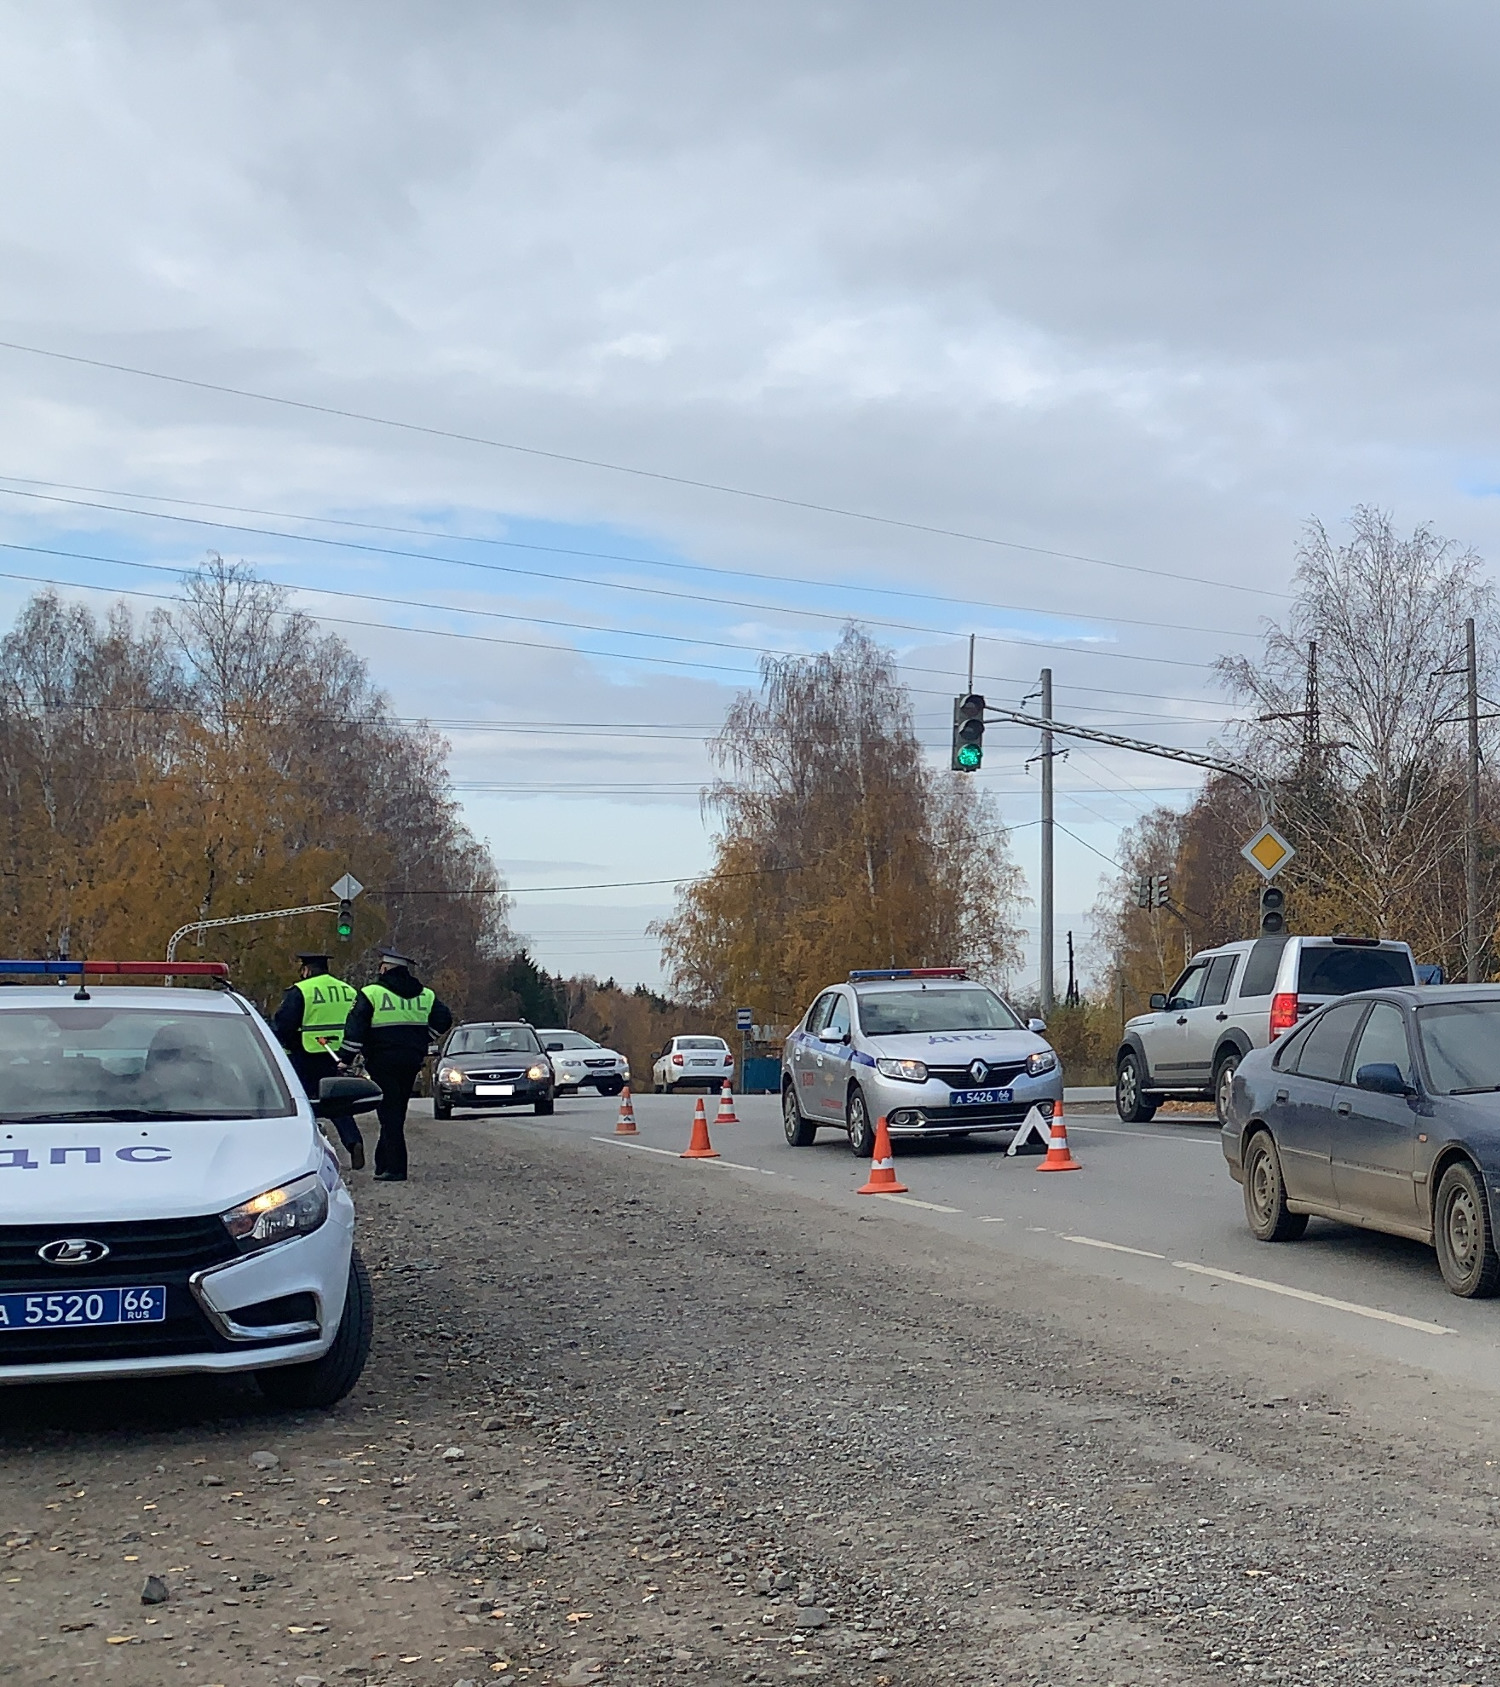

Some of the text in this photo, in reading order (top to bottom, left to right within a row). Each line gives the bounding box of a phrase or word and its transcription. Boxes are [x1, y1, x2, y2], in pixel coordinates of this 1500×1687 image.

[312, 986, 353, 1004] ДПС
[928, 1035, 997, 1045] ДПС
[955, 1095, 963, 1104] А
[966, 1091, 993, 1103] 5426
[25, 1294, 104, 1324] 5520
[124, 1290, 154, 1310] 66
[127, 1310, 150, 1319] RUS
